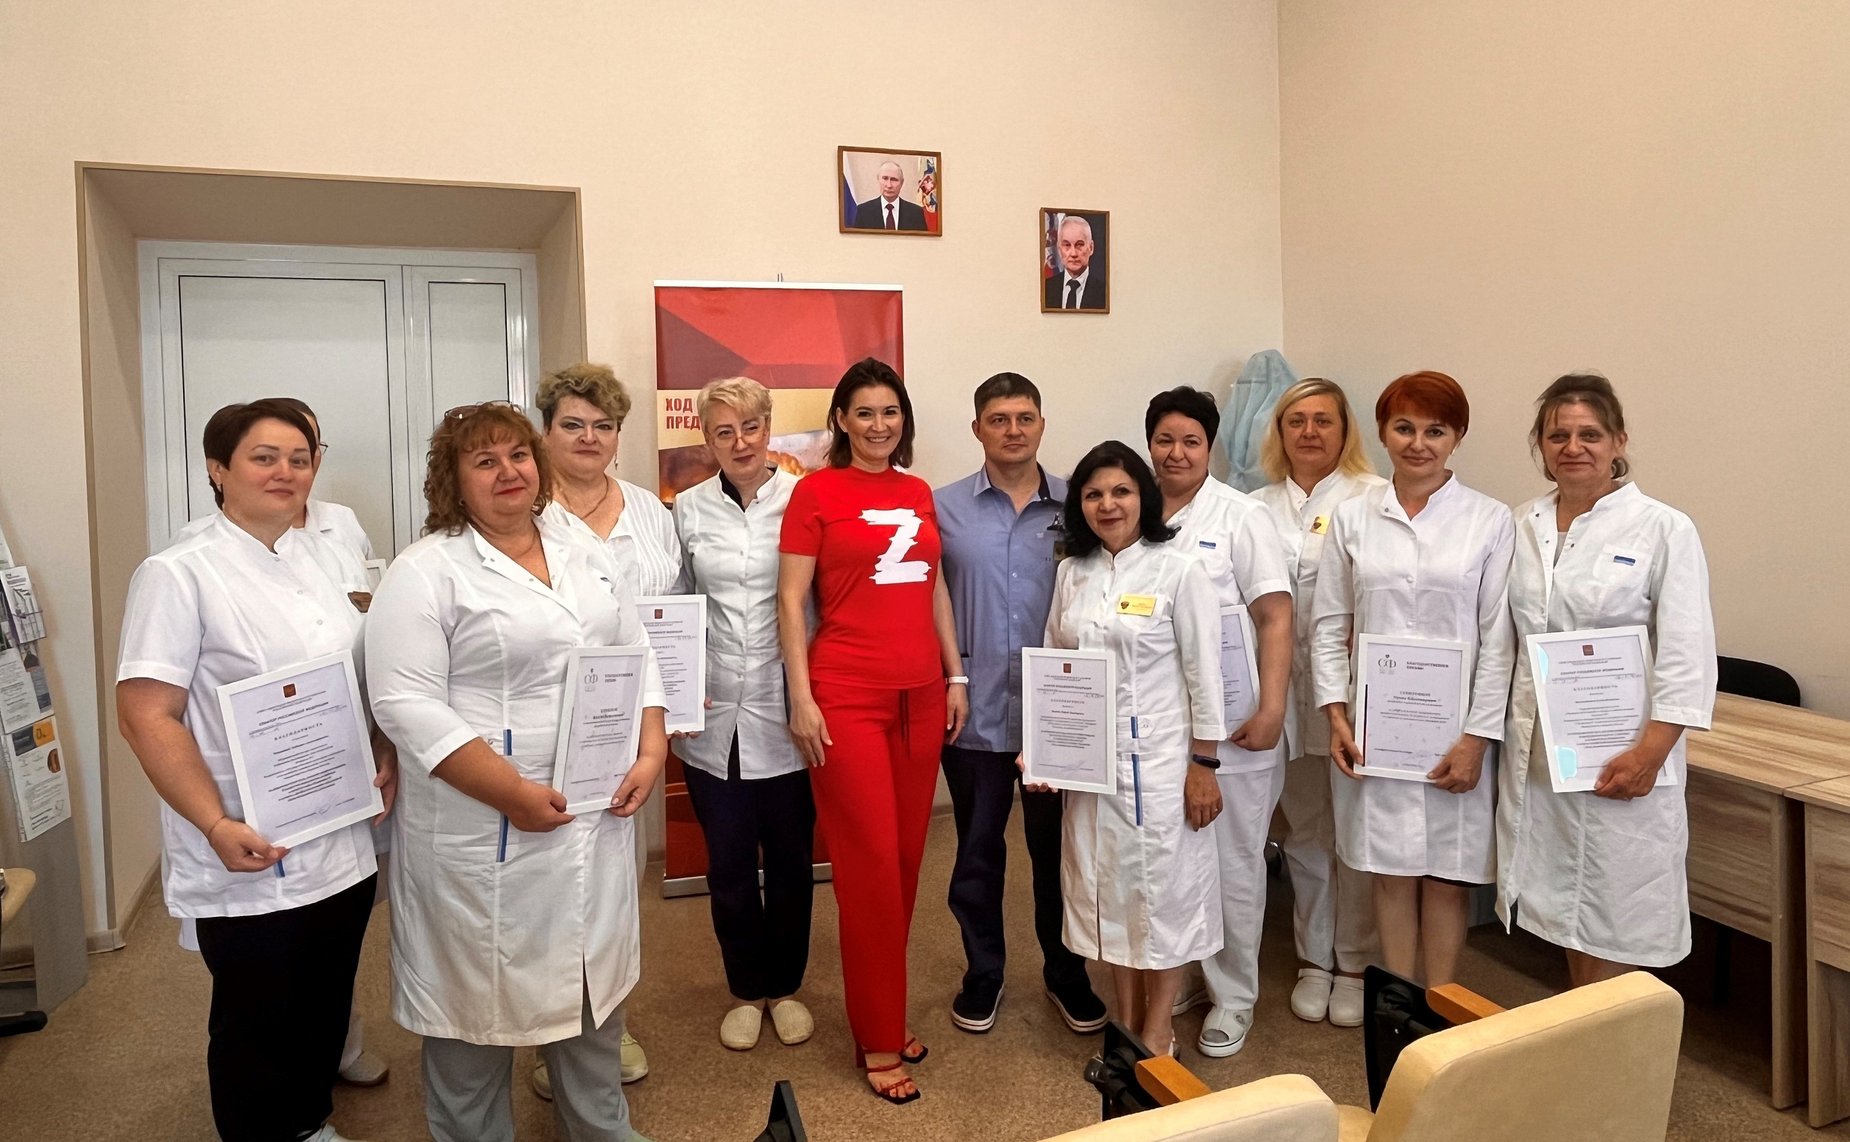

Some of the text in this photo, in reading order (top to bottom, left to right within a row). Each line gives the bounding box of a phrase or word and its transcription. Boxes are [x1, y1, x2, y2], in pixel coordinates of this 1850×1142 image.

[665, 398, 693, 413] ХОД
[666, 416, 700, 430] ПРЕД
[858, 508, 932, 585] Z
